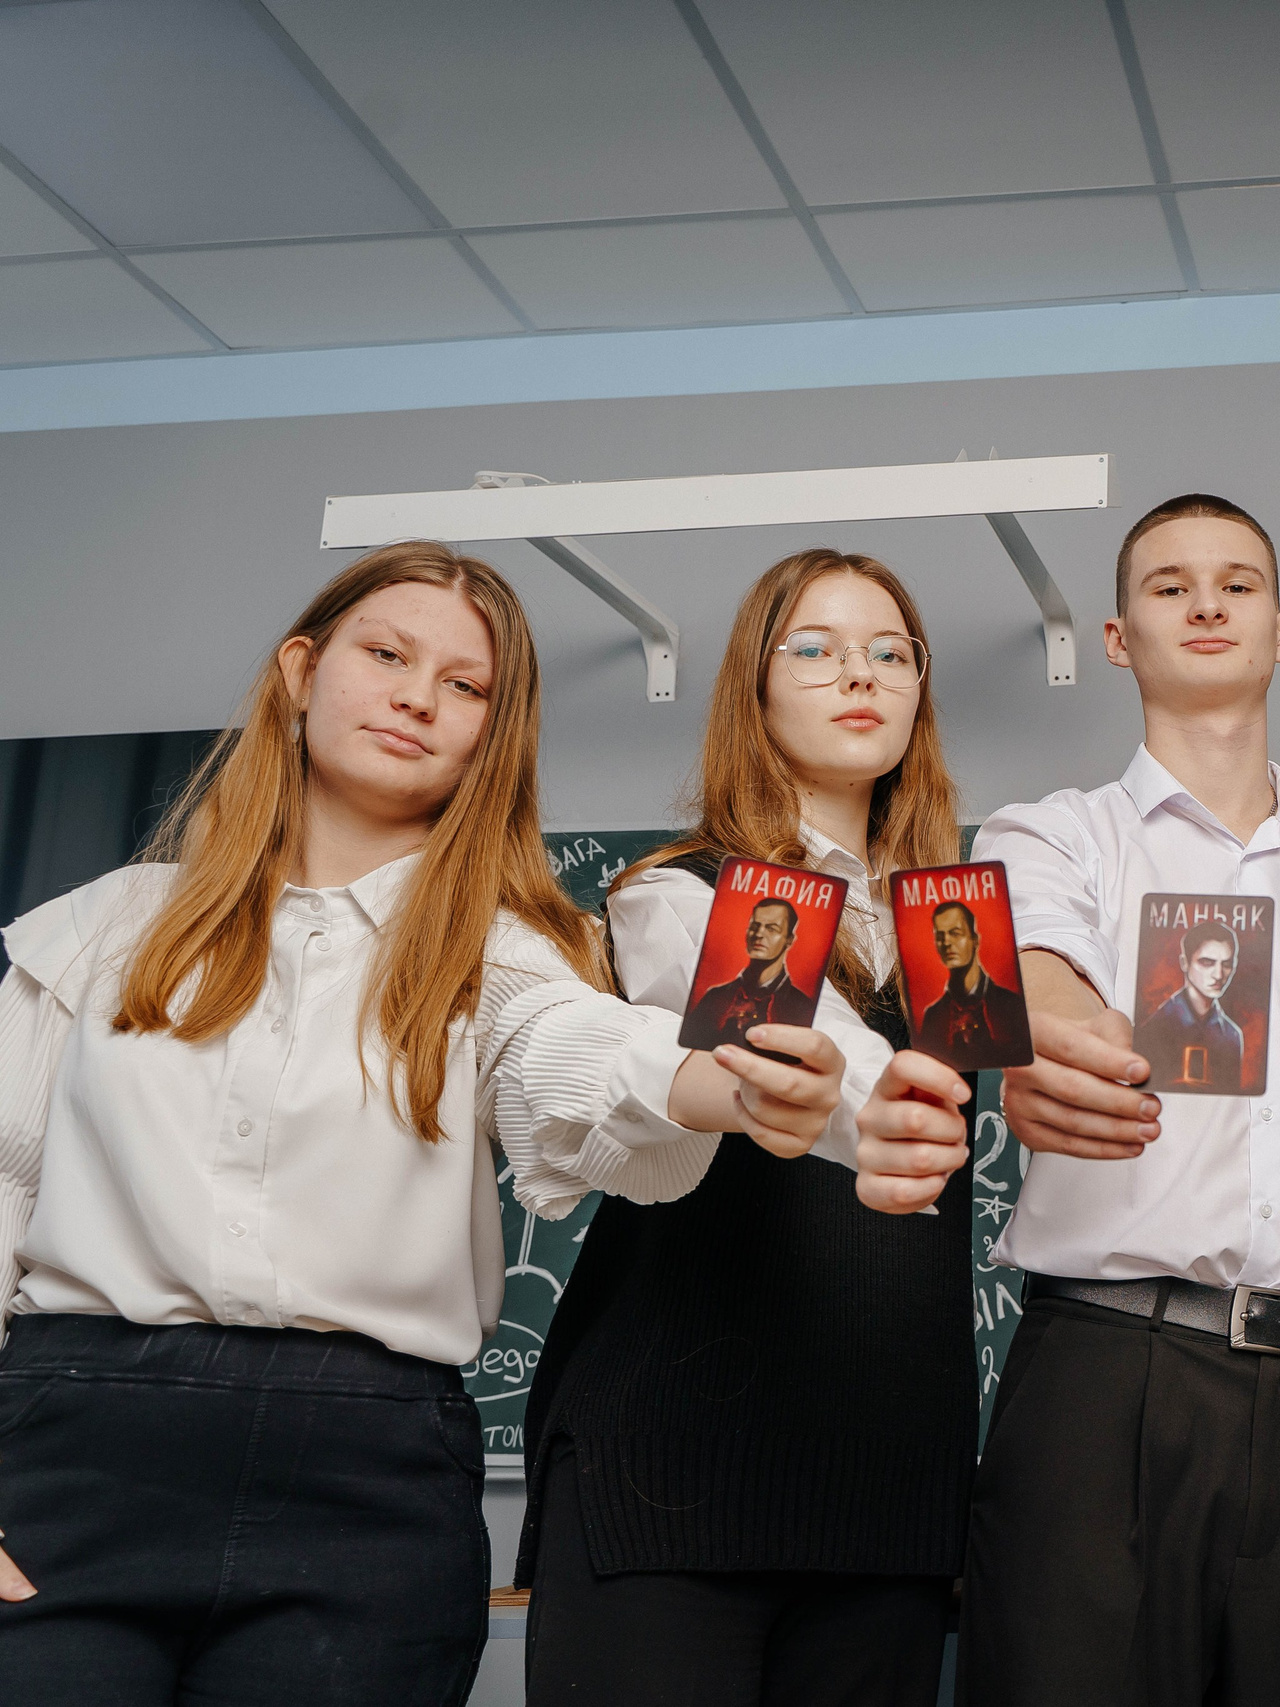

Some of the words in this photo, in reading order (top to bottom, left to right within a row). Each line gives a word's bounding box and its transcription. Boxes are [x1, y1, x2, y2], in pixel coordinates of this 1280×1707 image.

[730, 863, 834, 910] МАФИЯ
[902, 869, 997, 908] МАФИЯ
[1149, 901, 1266, 932] МАНЬЯК
